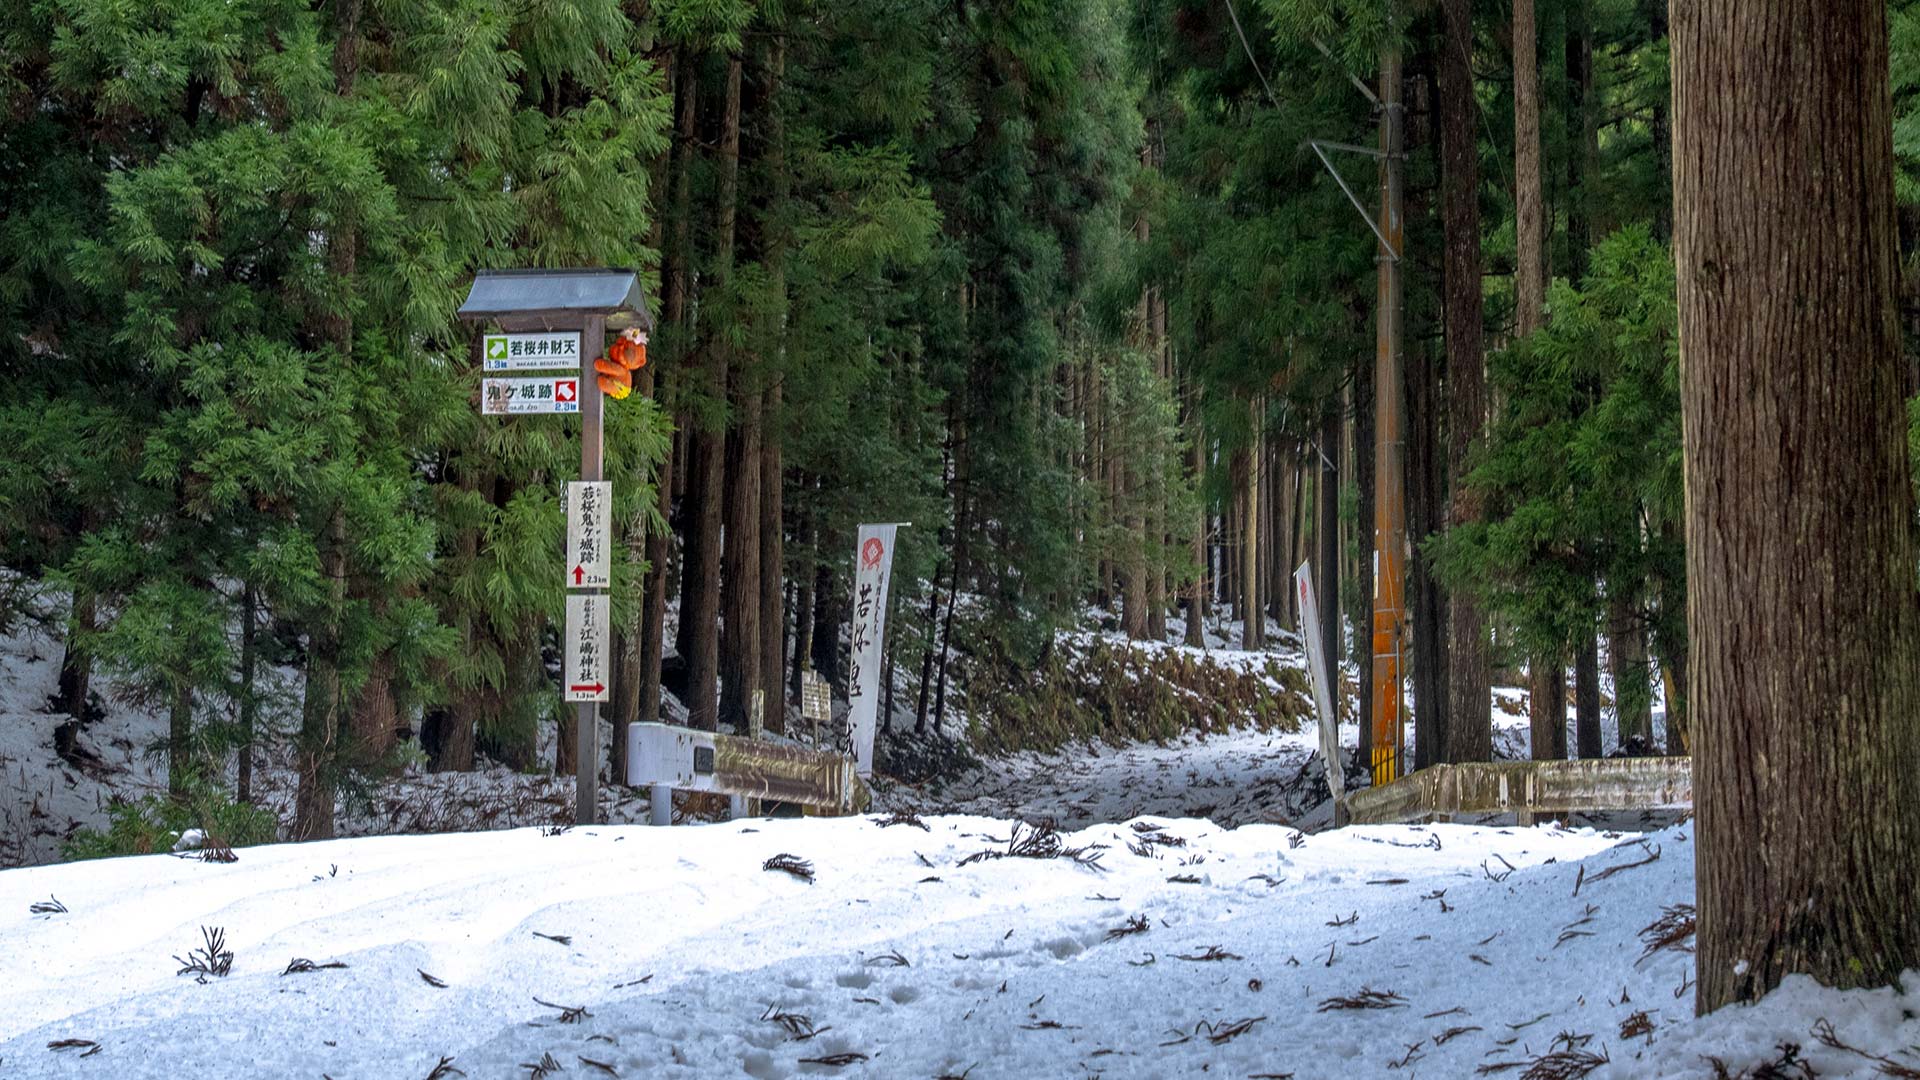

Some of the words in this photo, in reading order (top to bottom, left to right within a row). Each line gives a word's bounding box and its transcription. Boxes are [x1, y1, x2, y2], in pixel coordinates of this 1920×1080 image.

[510, 339, 576, 356] 若桜弁財天
